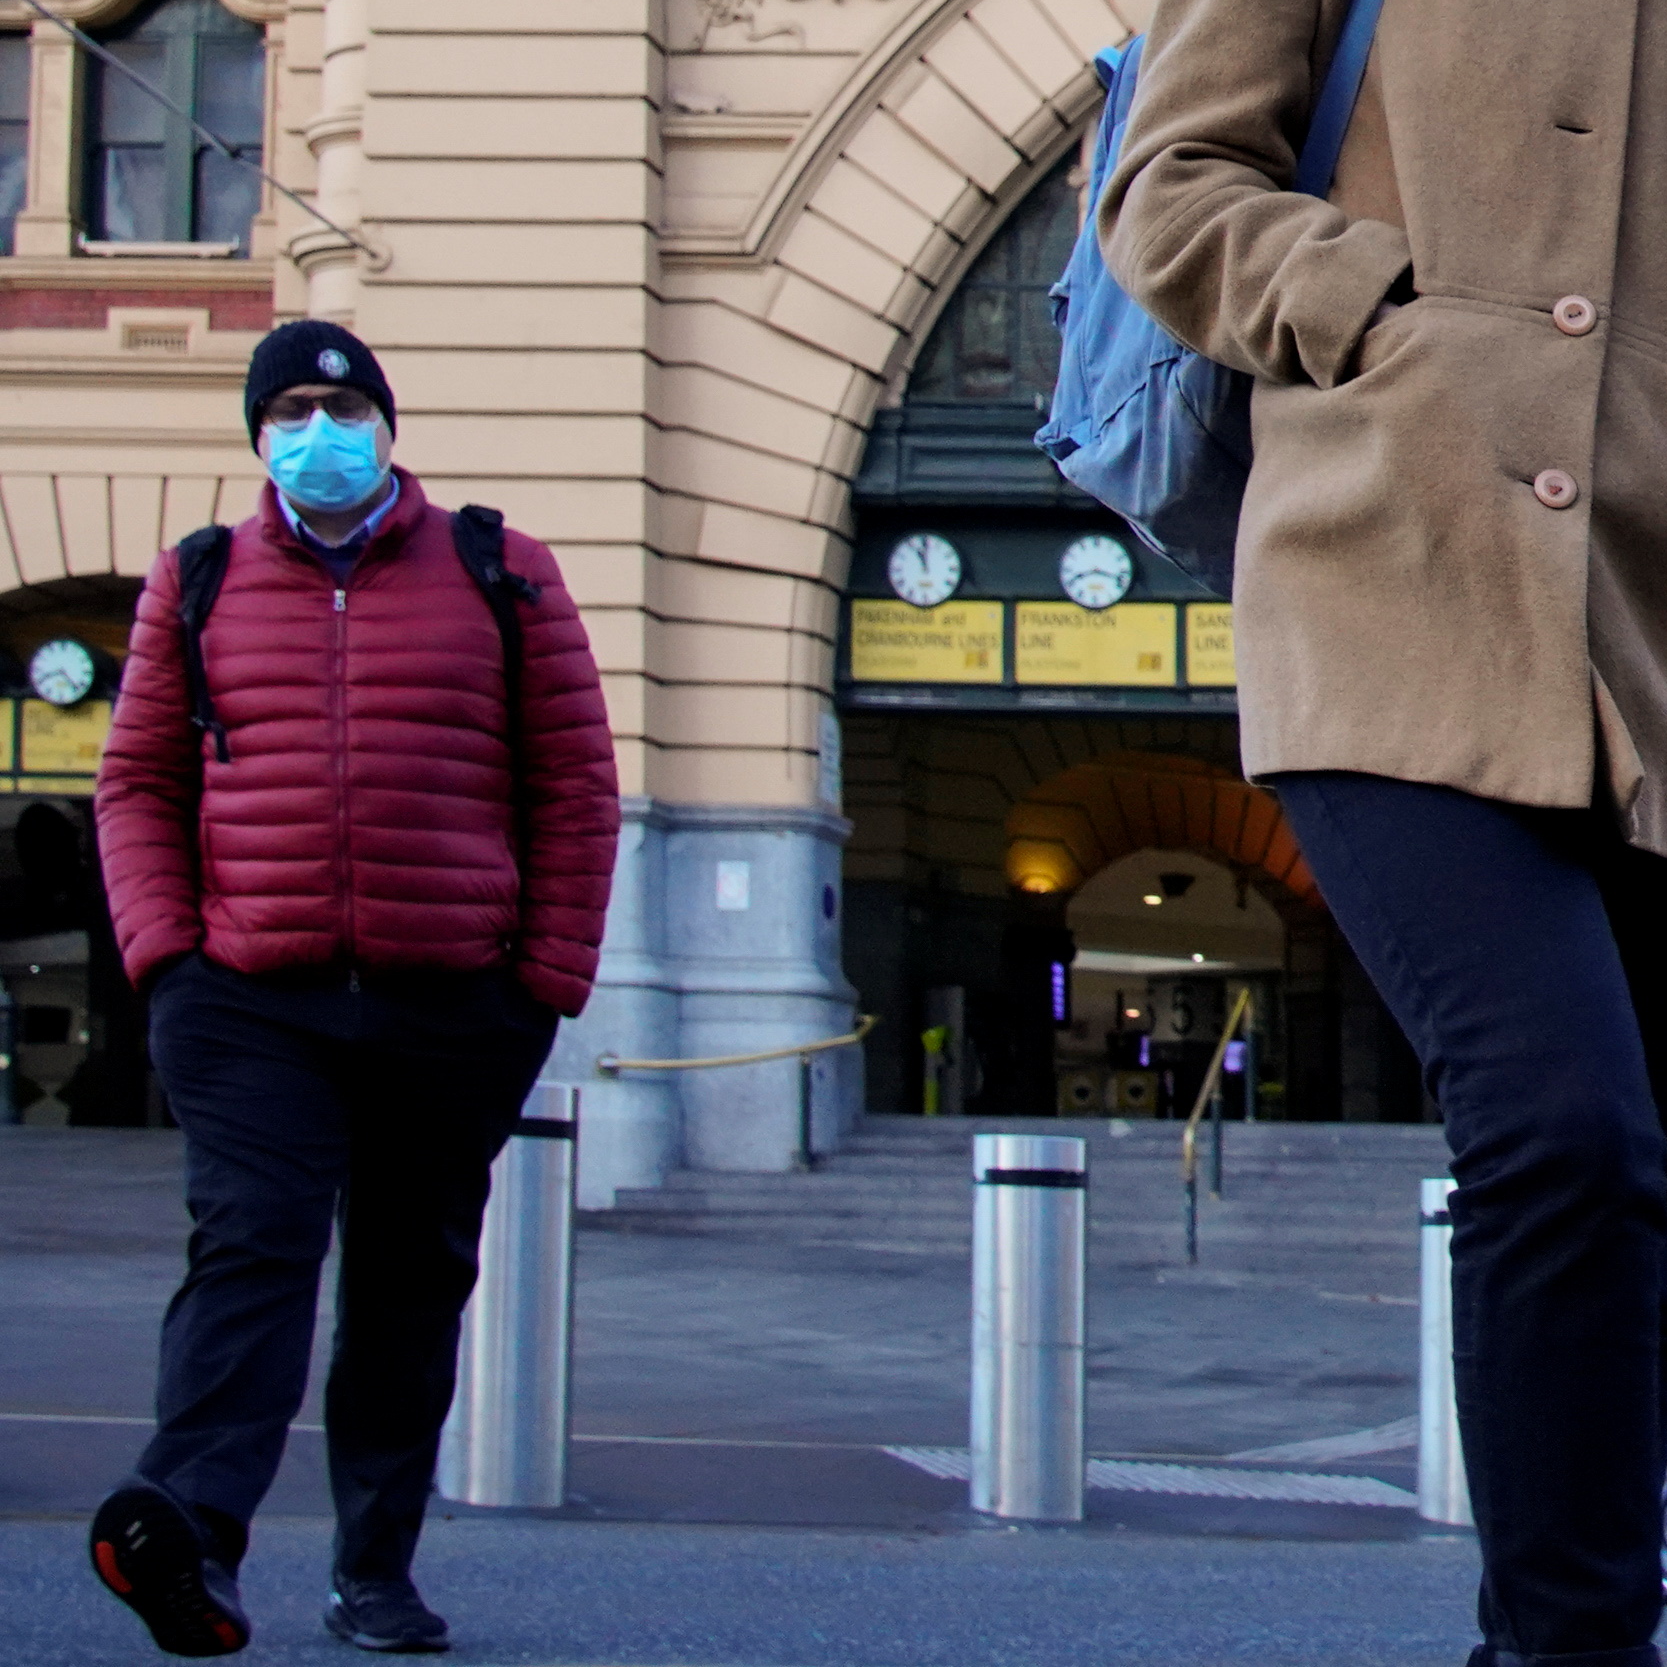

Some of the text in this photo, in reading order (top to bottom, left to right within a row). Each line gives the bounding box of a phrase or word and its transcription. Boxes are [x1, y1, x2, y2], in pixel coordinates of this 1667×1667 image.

[1021, 612, 1117, 628] FRANKSTON
[1020, 634, 1054, 649] LINE
[1195, 634, 1229, 651] LINE
